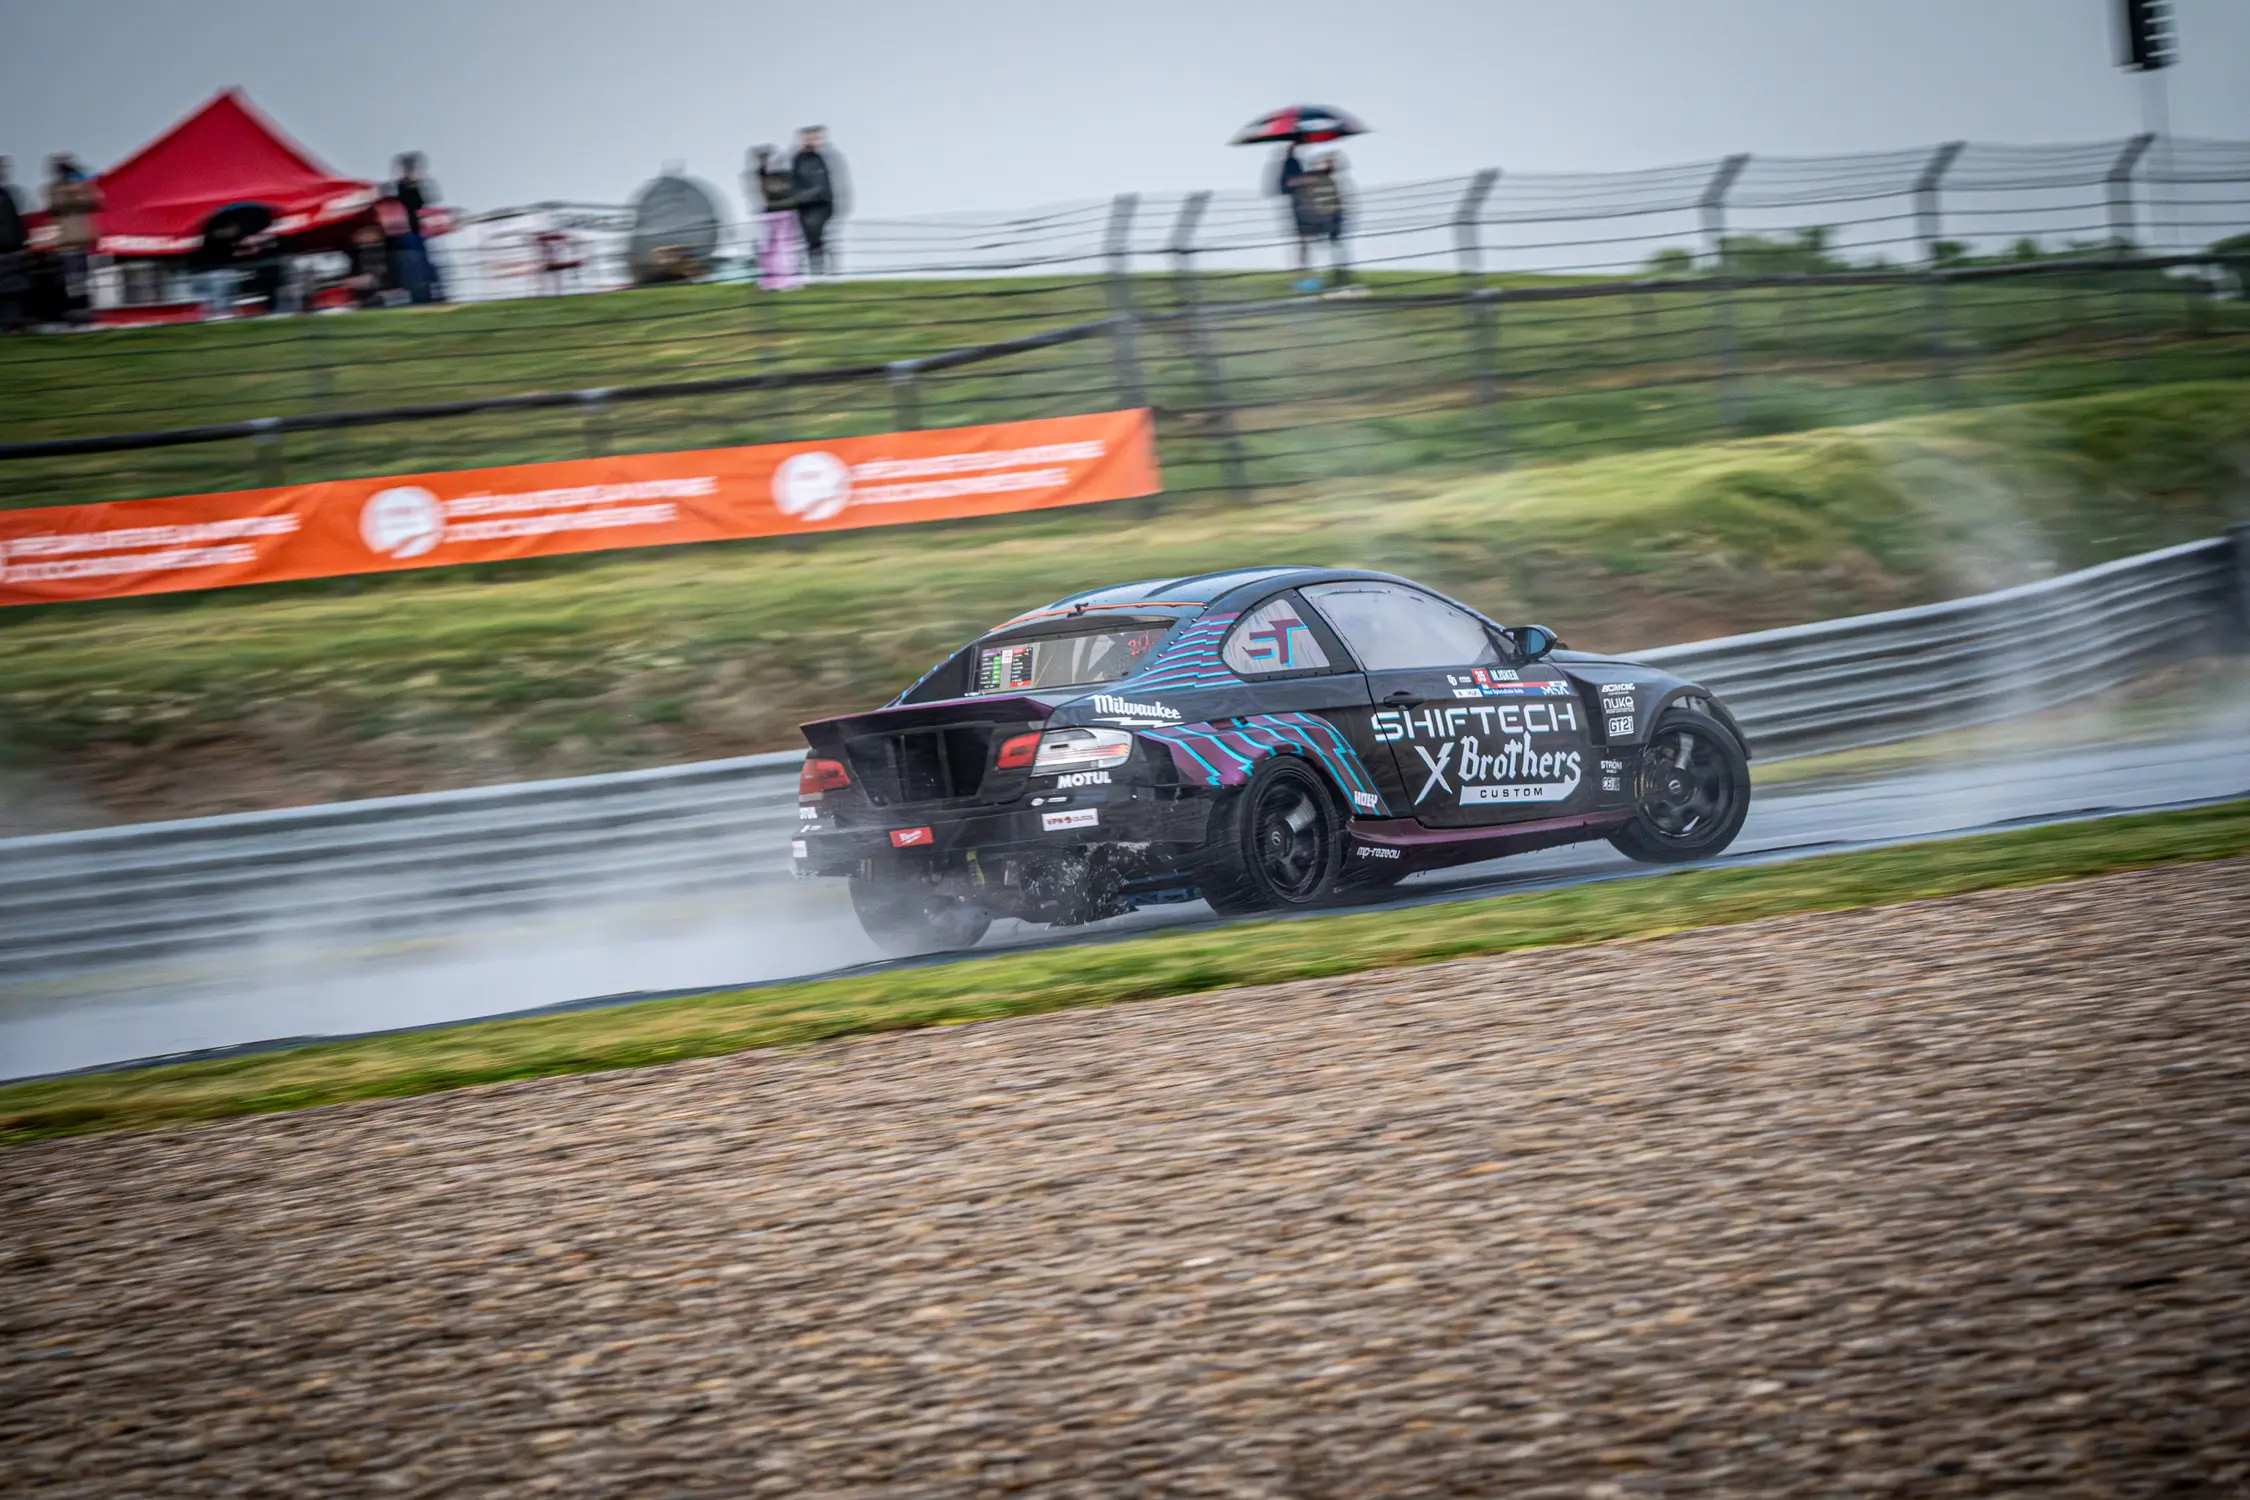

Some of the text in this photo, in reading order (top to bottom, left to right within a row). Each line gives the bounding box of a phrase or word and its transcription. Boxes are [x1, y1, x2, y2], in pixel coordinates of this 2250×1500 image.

[1086, 694, 1182, 719] Milwaukee
[1603, 696, 1634, 709] nuke
[1370, 702, 1578, 742] SHIFTECH
[1458, 730, 1582, 784] Brothers
[1057, 771, 1112, 789] MOTUL
[1480, 787, 1543, 799] CUSTOM
